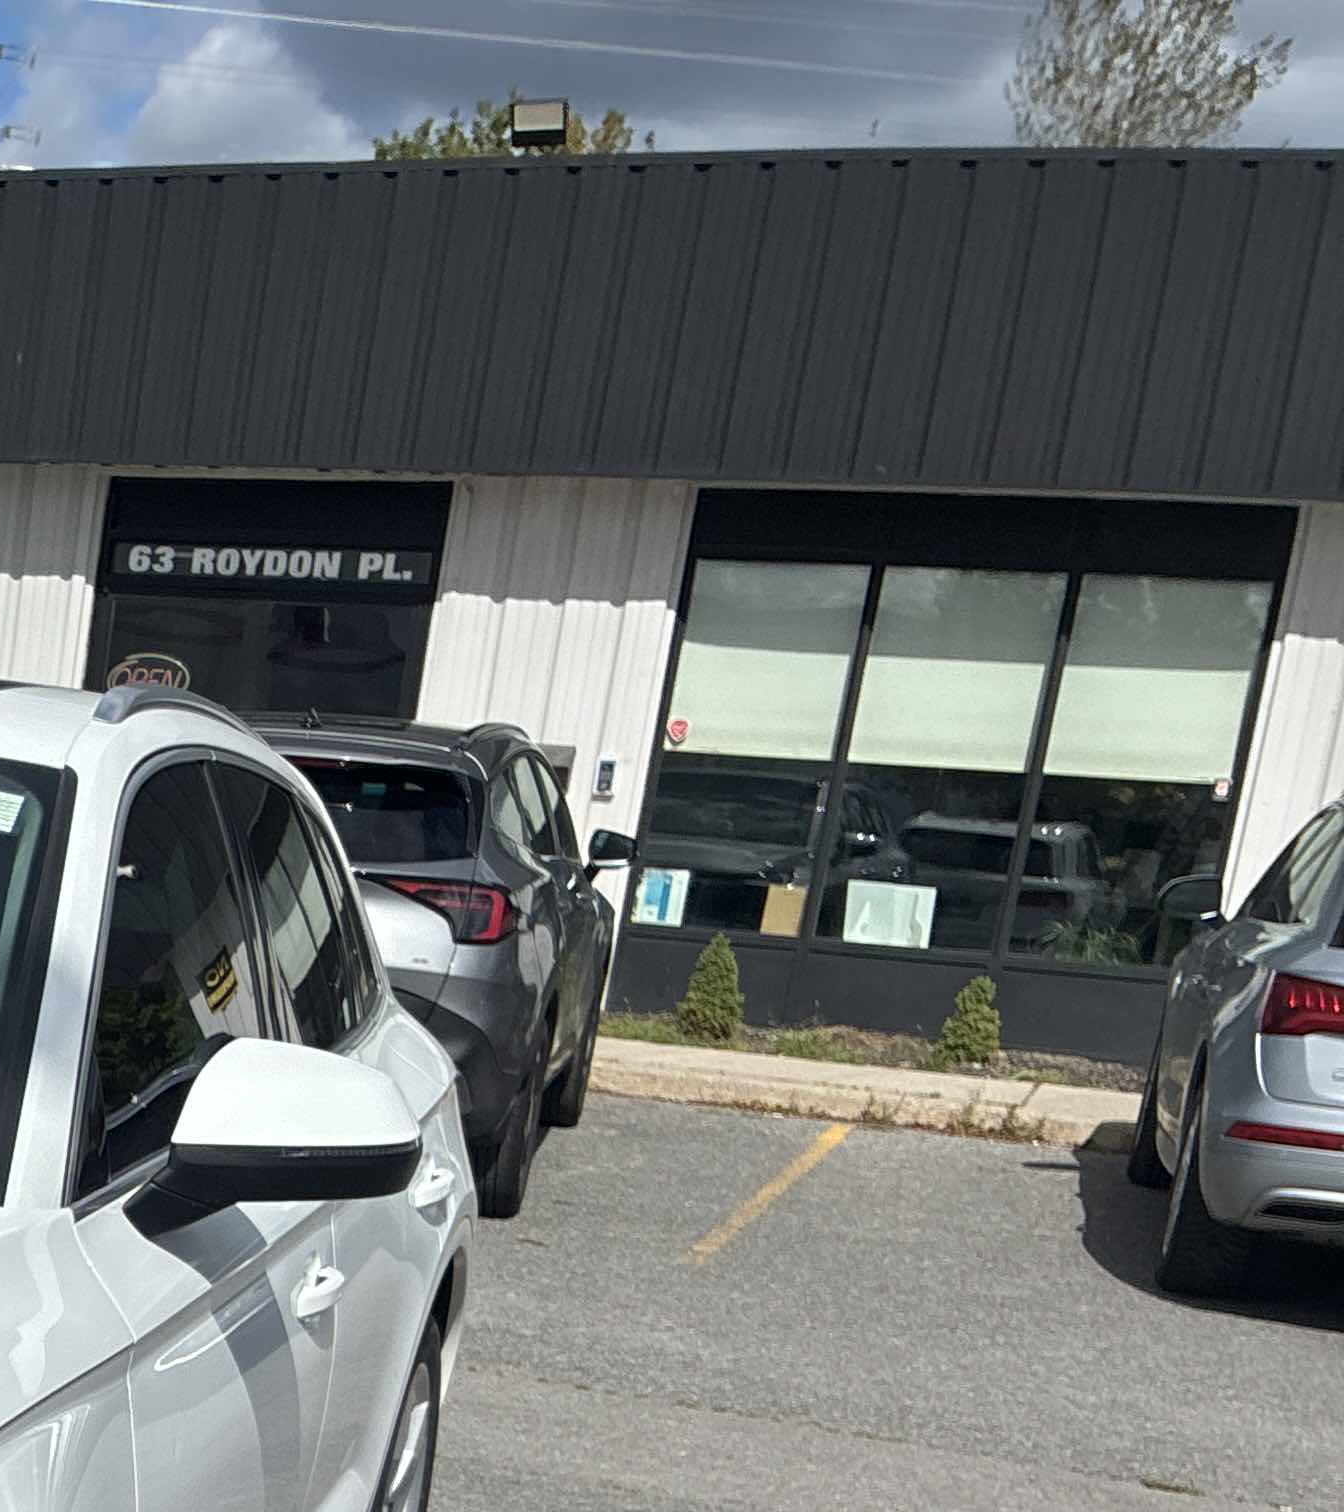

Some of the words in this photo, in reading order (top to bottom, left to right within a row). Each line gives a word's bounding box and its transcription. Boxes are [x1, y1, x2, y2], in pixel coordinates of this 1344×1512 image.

[127, 545, 175, 574] 63
[191, 548, 341, 580] ROYDON
[358, 552, 413, 581] PL.
